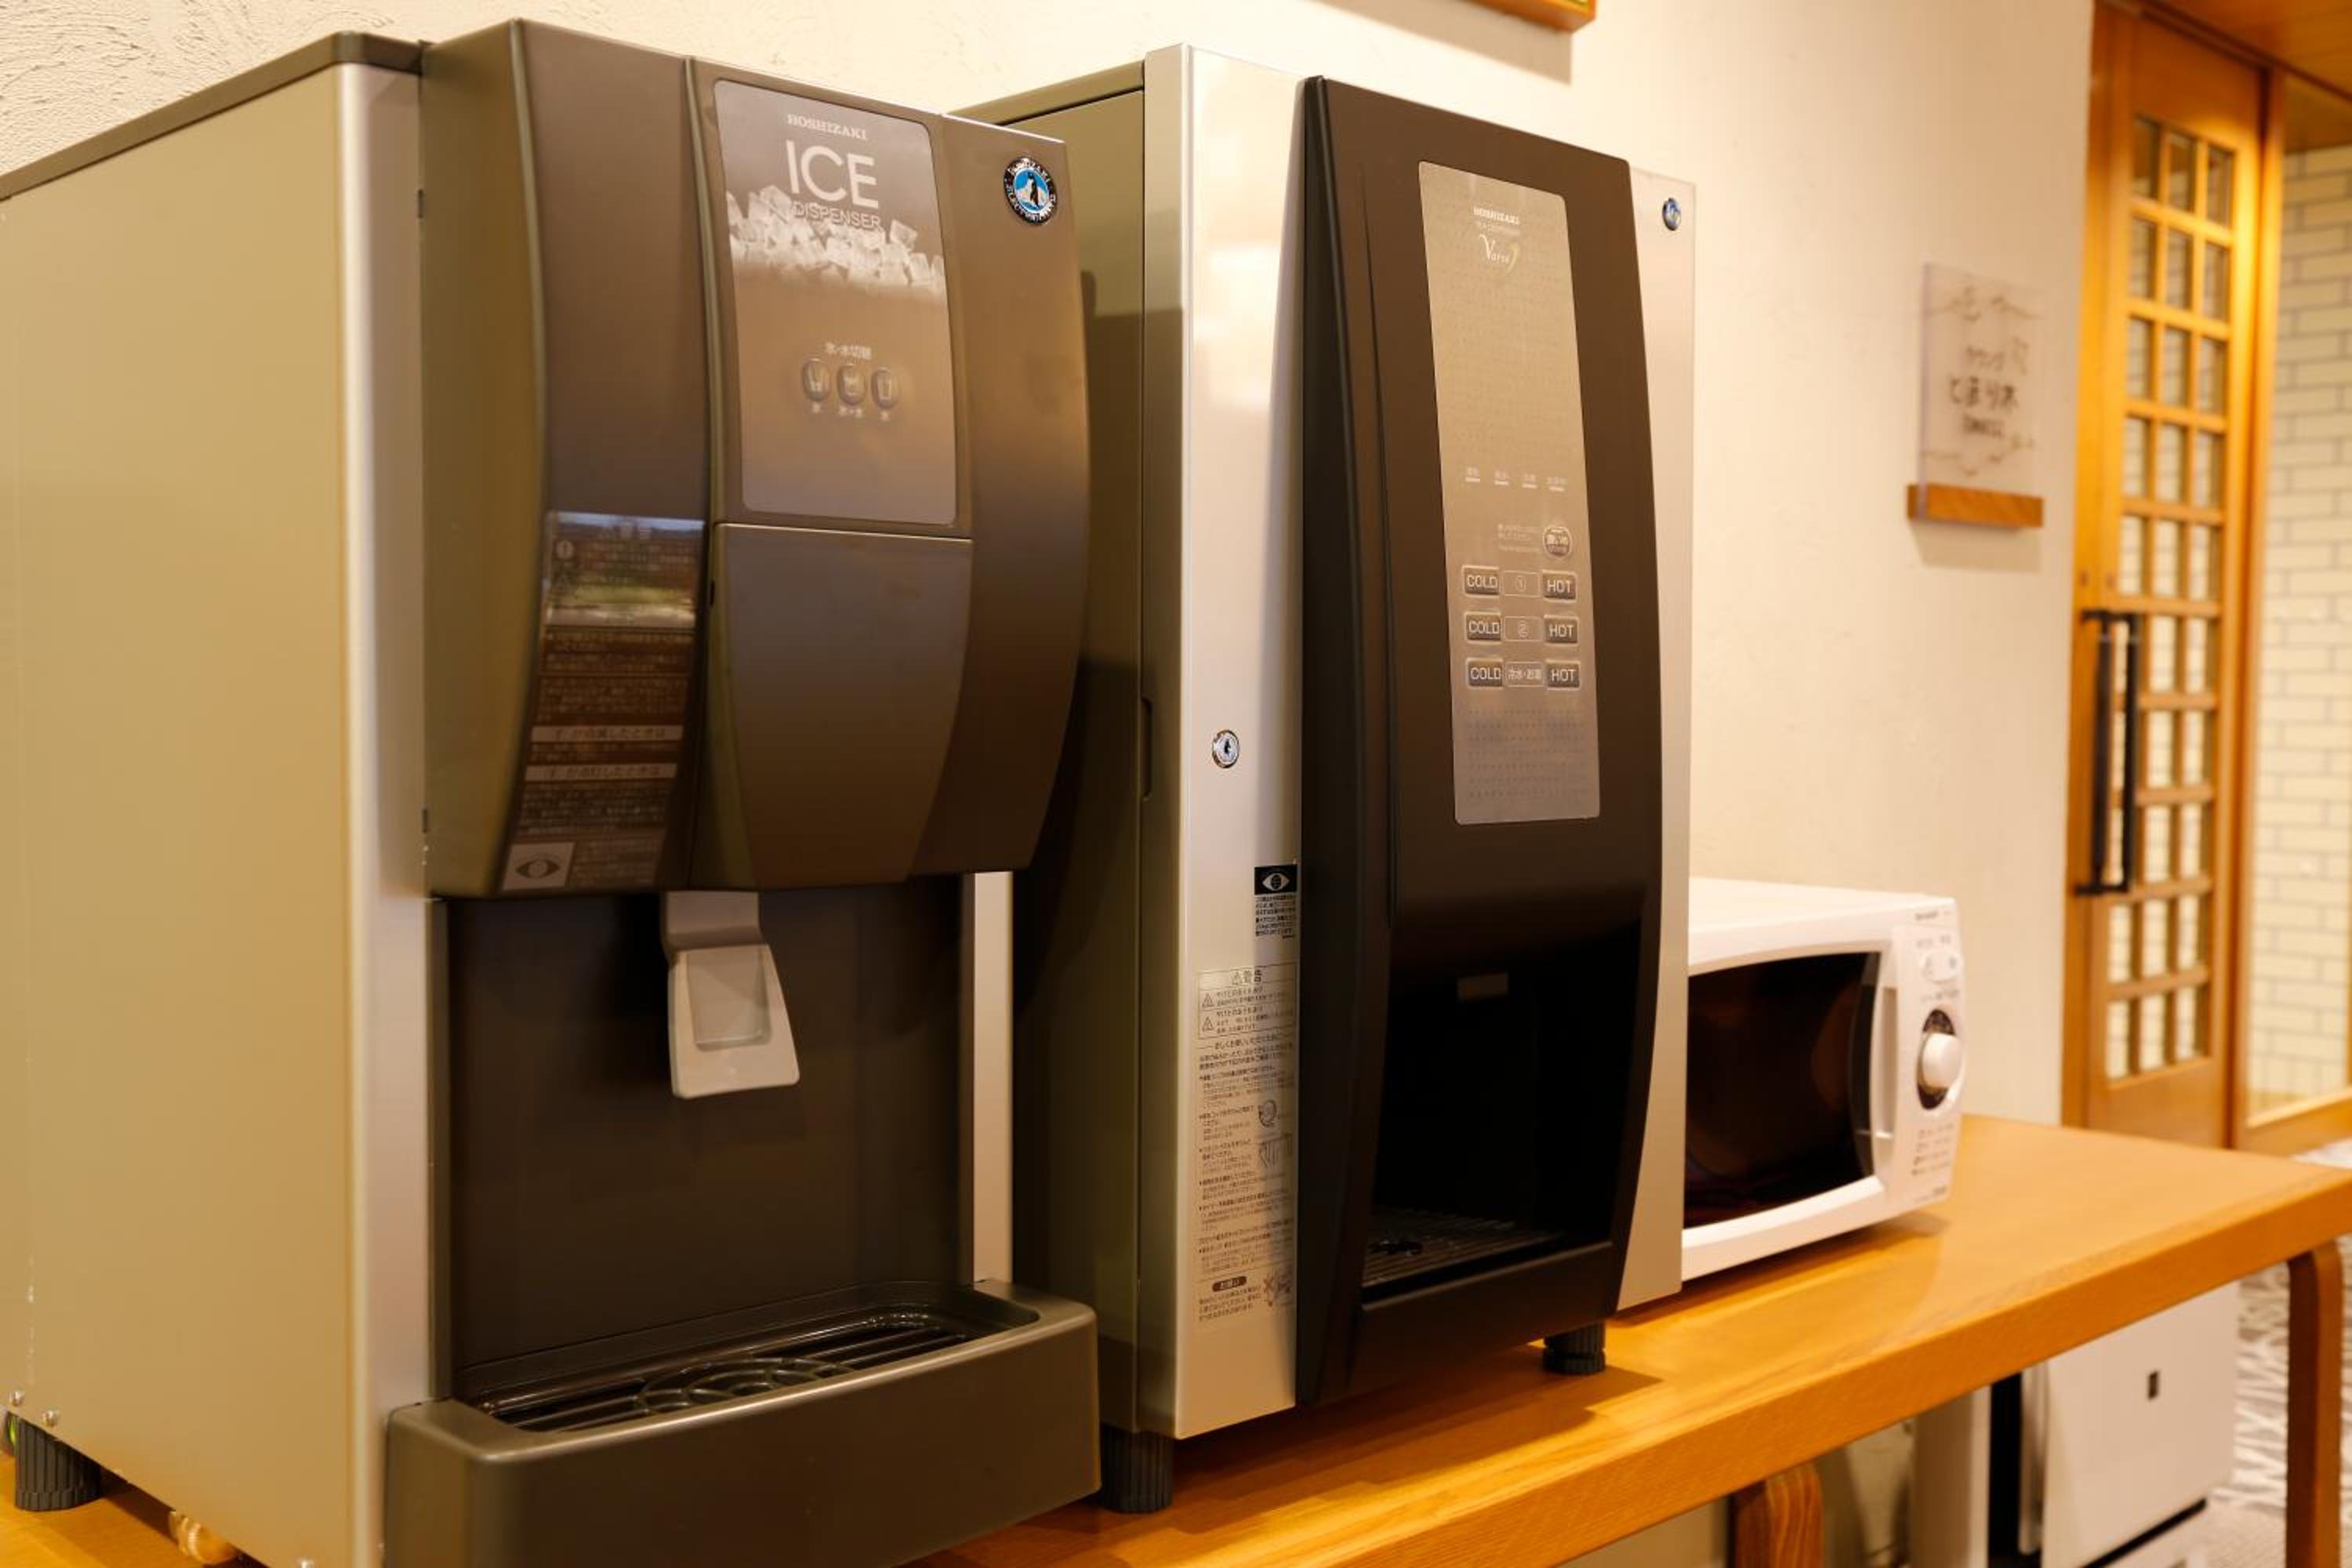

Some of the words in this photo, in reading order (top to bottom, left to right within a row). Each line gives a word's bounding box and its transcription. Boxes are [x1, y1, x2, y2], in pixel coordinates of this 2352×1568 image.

[787, 114, 867, 140] HOSHIZAKI
[786, 139, 880, 209] ICE
[793, 201, 880, 230] DISPENSER
[1466, 574, 1499, 589] COLD
[1546, 579, 1573, 593] HOT
[1468, 620, 1501, 635] COLD
[1548, 623, 1574, 638] HOT
[1470, 666, 1502, 681] COLD
[1551, 668, 1577, 683] HOT
